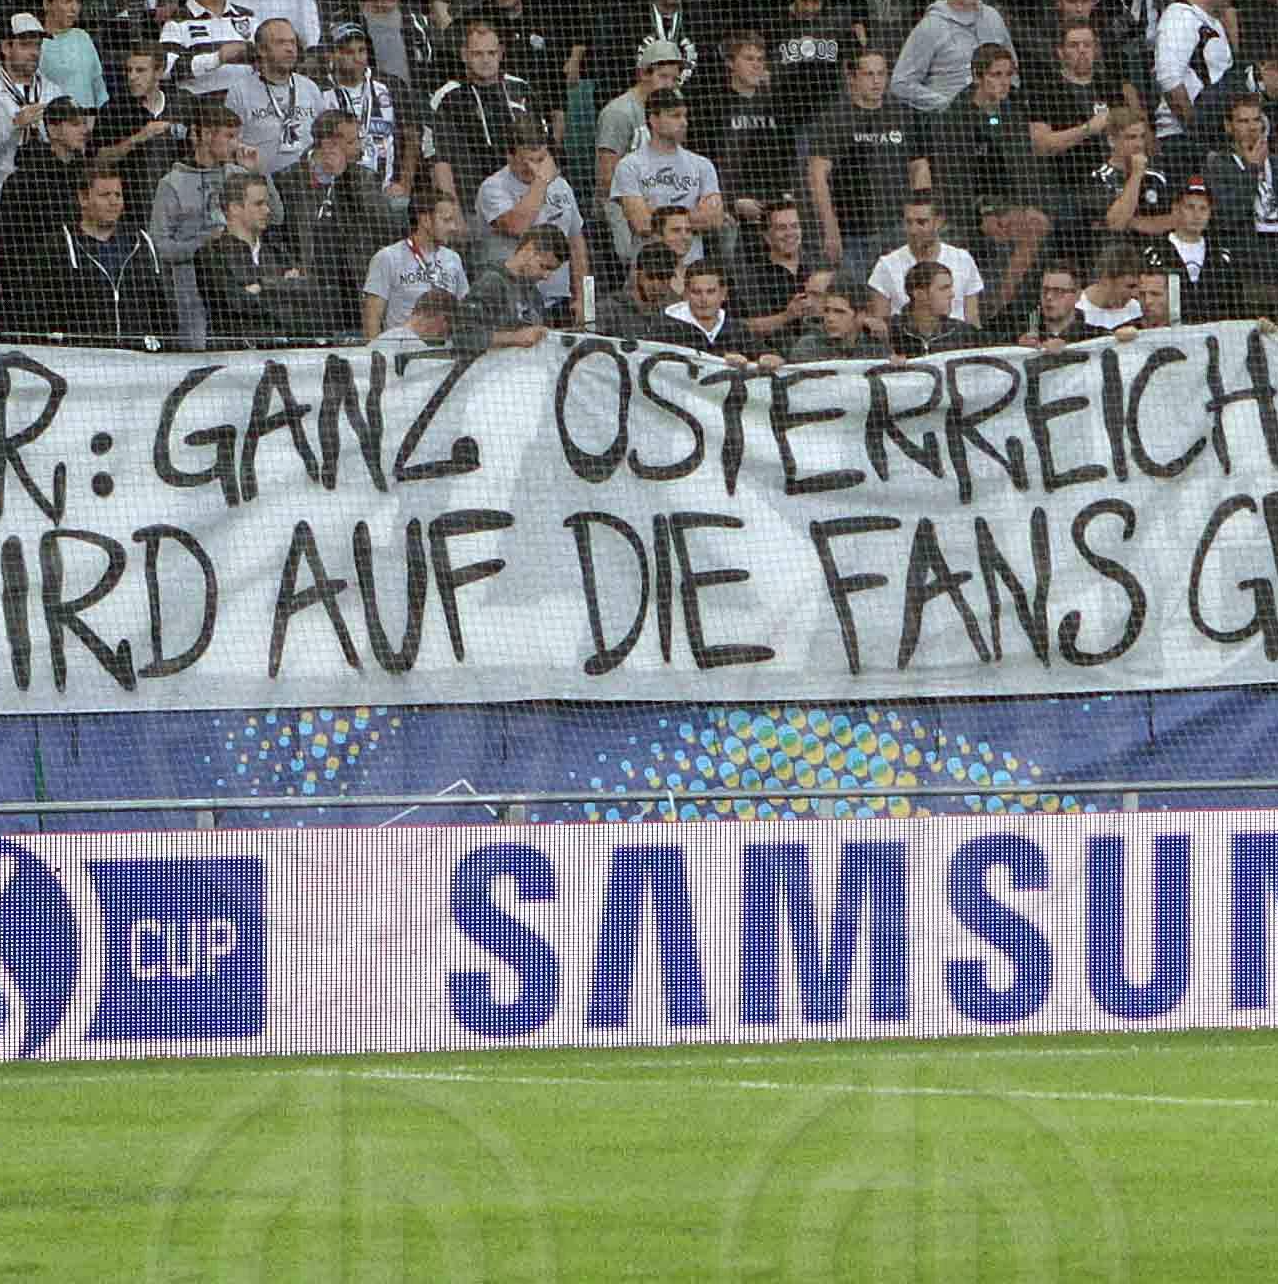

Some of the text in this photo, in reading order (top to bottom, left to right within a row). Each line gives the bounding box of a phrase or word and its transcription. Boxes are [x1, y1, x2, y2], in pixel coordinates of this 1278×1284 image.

[154, 348, 483, 507] GANZ
[268, 507, 516, 679] AUF
[563, 510, 776, 676] DIE
[811, 509, 1147, 676] FANS
[128, 916, 238, 980] CUP
